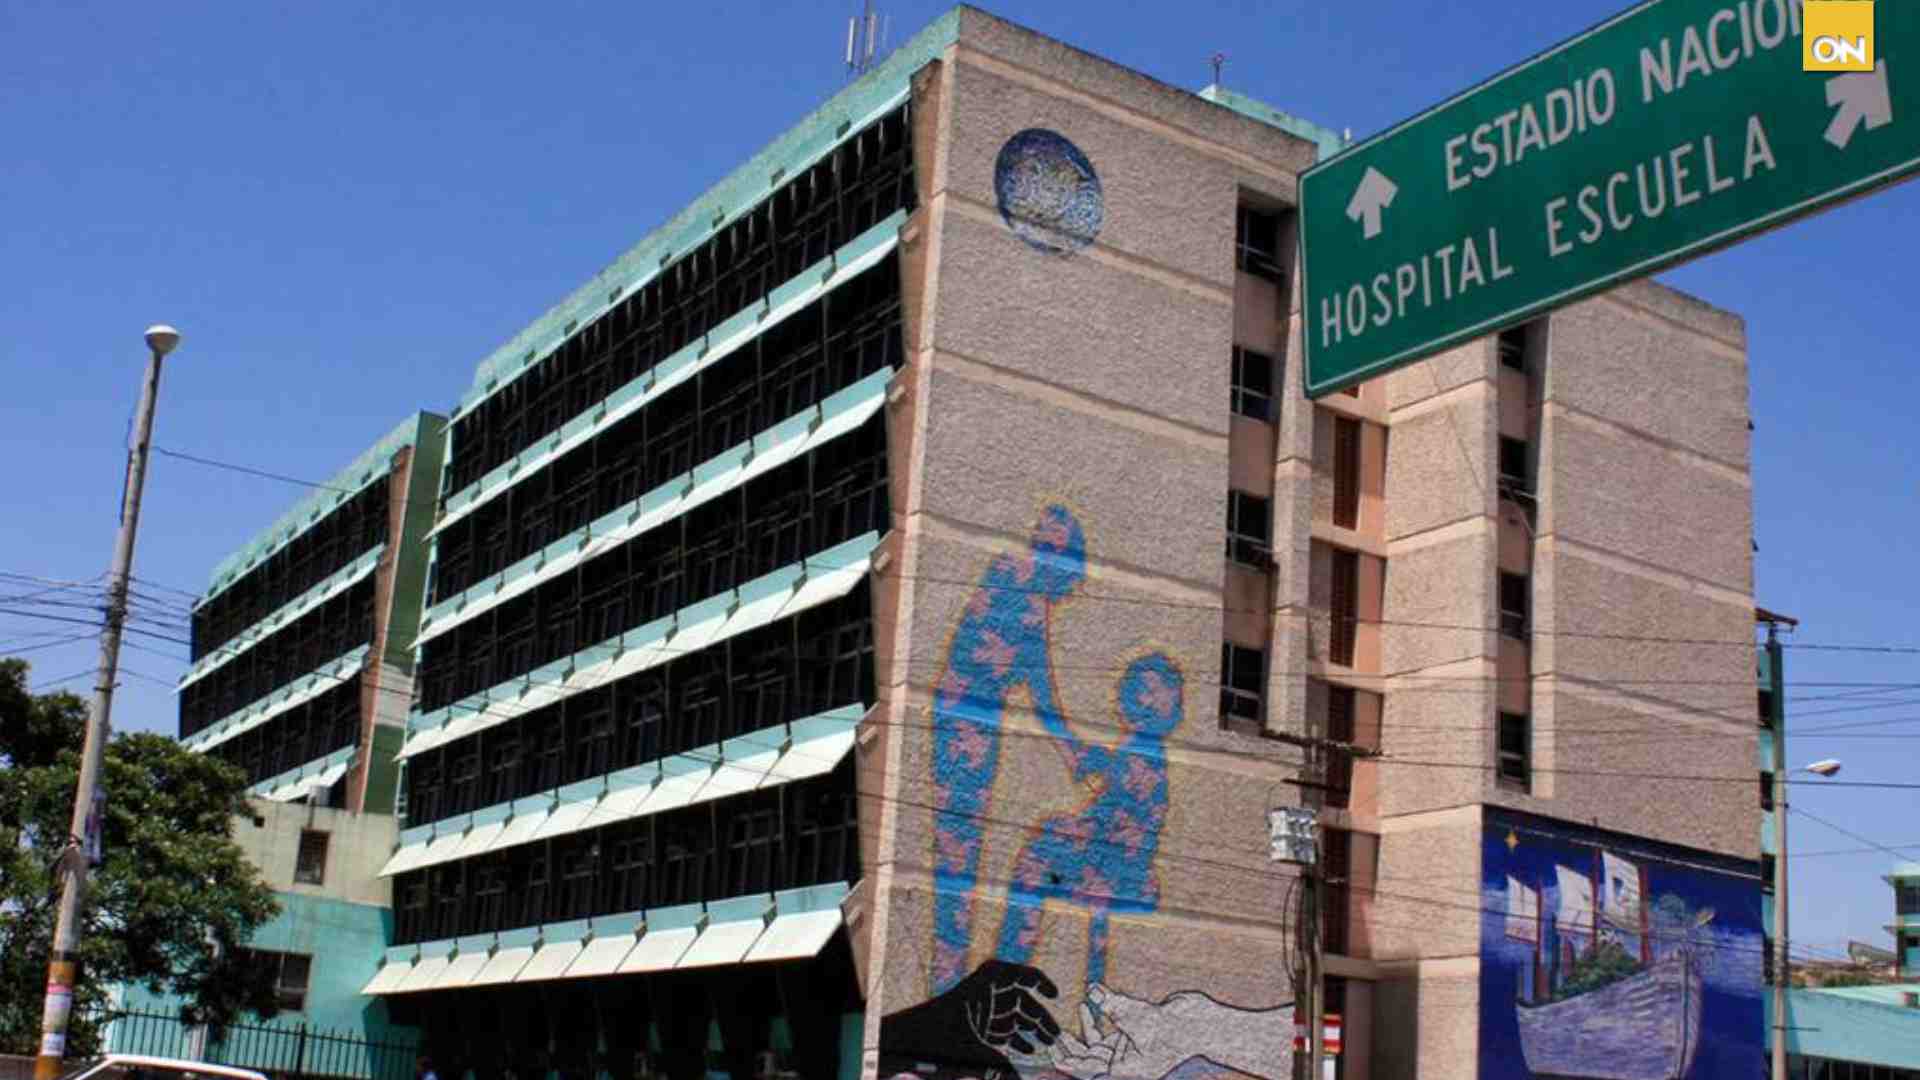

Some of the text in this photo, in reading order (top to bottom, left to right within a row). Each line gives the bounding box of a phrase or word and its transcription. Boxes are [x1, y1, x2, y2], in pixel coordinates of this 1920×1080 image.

[1444, 69, 1615, 191] ESTADIO
[1321, 115, 1777, 347] HOSPITAL ESCUELA
